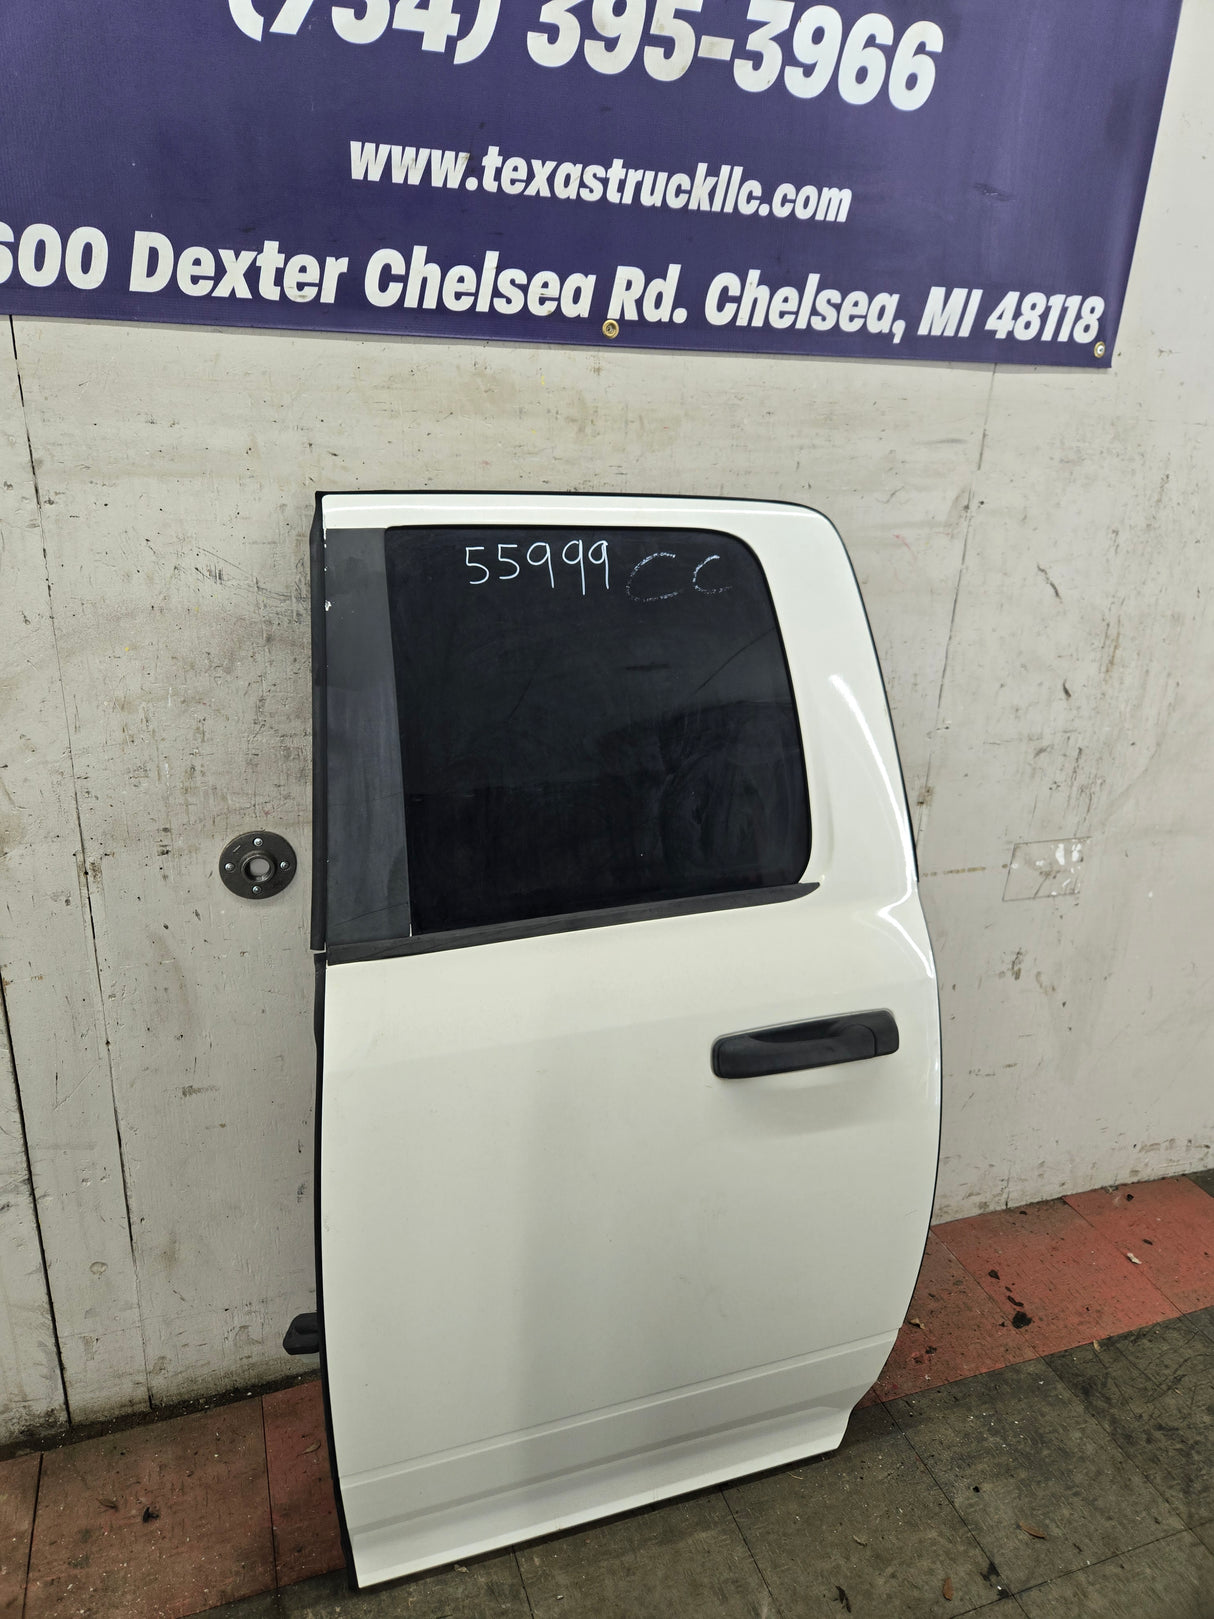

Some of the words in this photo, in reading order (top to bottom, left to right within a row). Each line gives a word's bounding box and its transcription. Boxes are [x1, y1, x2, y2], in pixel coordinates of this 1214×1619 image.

[526, 0, 944, 112] 395-3966
[350, 140, 853, 223] www.texastruckllc.com
[128, 230, 349, 306] Dexter
[364, 245, 597, 319] Chelsea
[606, 263, 688, 324] Rd.
[704, 268, 906, 344] Chelsea,
[917, 286, 984, 338] MI
[984, 290, 1105, 344] 48118
[465, 539, 609, 596] 55999
